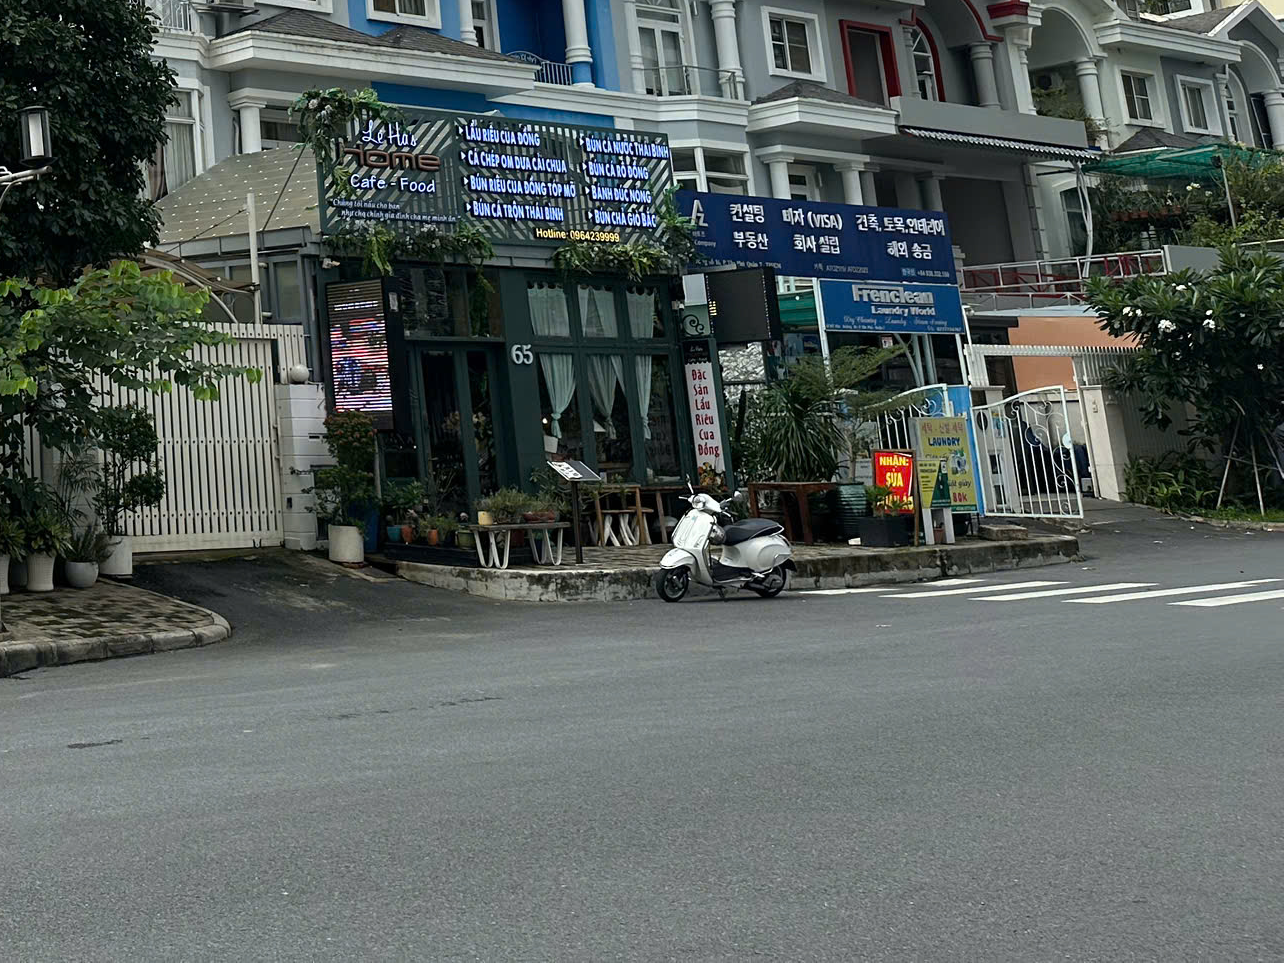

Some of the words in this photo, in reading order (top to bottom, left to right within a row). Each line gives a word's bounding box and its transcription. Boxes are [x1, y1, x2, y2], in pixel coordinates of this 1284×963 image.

[500, 130, 517, 145] CUA
[585, 135, 602, 152] BÚN
[602, 137, 613, 153] CÁ
[468, 148, 480, 166] CÁ
[481, 149, 500, 168] CHÉP
[501, 154, 514, 169] OM
[546, 158, 567, 174] CHUA
[588, 159, 605, 176] BÚN
[606, 161, 616, 177] CÁ
[400, 178, 436, 193] Food
[469, 173, 488, 191] BÚN
[507, 179, 523, 194] CUA
[547, 179, 562, 197] TÓP
[591, 183, 614, 200] BÁNH
[473, 198, 490, 217] BÚN
[491, 200, 503, 217] CÁ
[525, 202, 544, 220] THÁI
[594, 207, 611, 225] BÚN
[729, 203, 765, 224] 컨설팅
[781, 207, 805, 227] 비자
[806, 211, 844, 231] (VISA)
[536, 227, 569, 240] Hotline:
[570, 229, 620, 243] 0964239999
[733, 231, 769, 250] 부동산
[793, 234, 817, 254] 회사
[818, 235, 841, 255] 설립
[886, 240, 909, 259] 해외
[911, 243, 933, 260] 송금
[851, 284, 934, 304] Frenclean
[871, 305, 909, 317] Laundry
[910, 306, 936, 316] World
[511, 344, 534, 365] 65
[699, 428, 715, 441] Cua
[927, 436, 961, 447] LAUNDRY
[879, 454, 909, 468] NHẬN:
